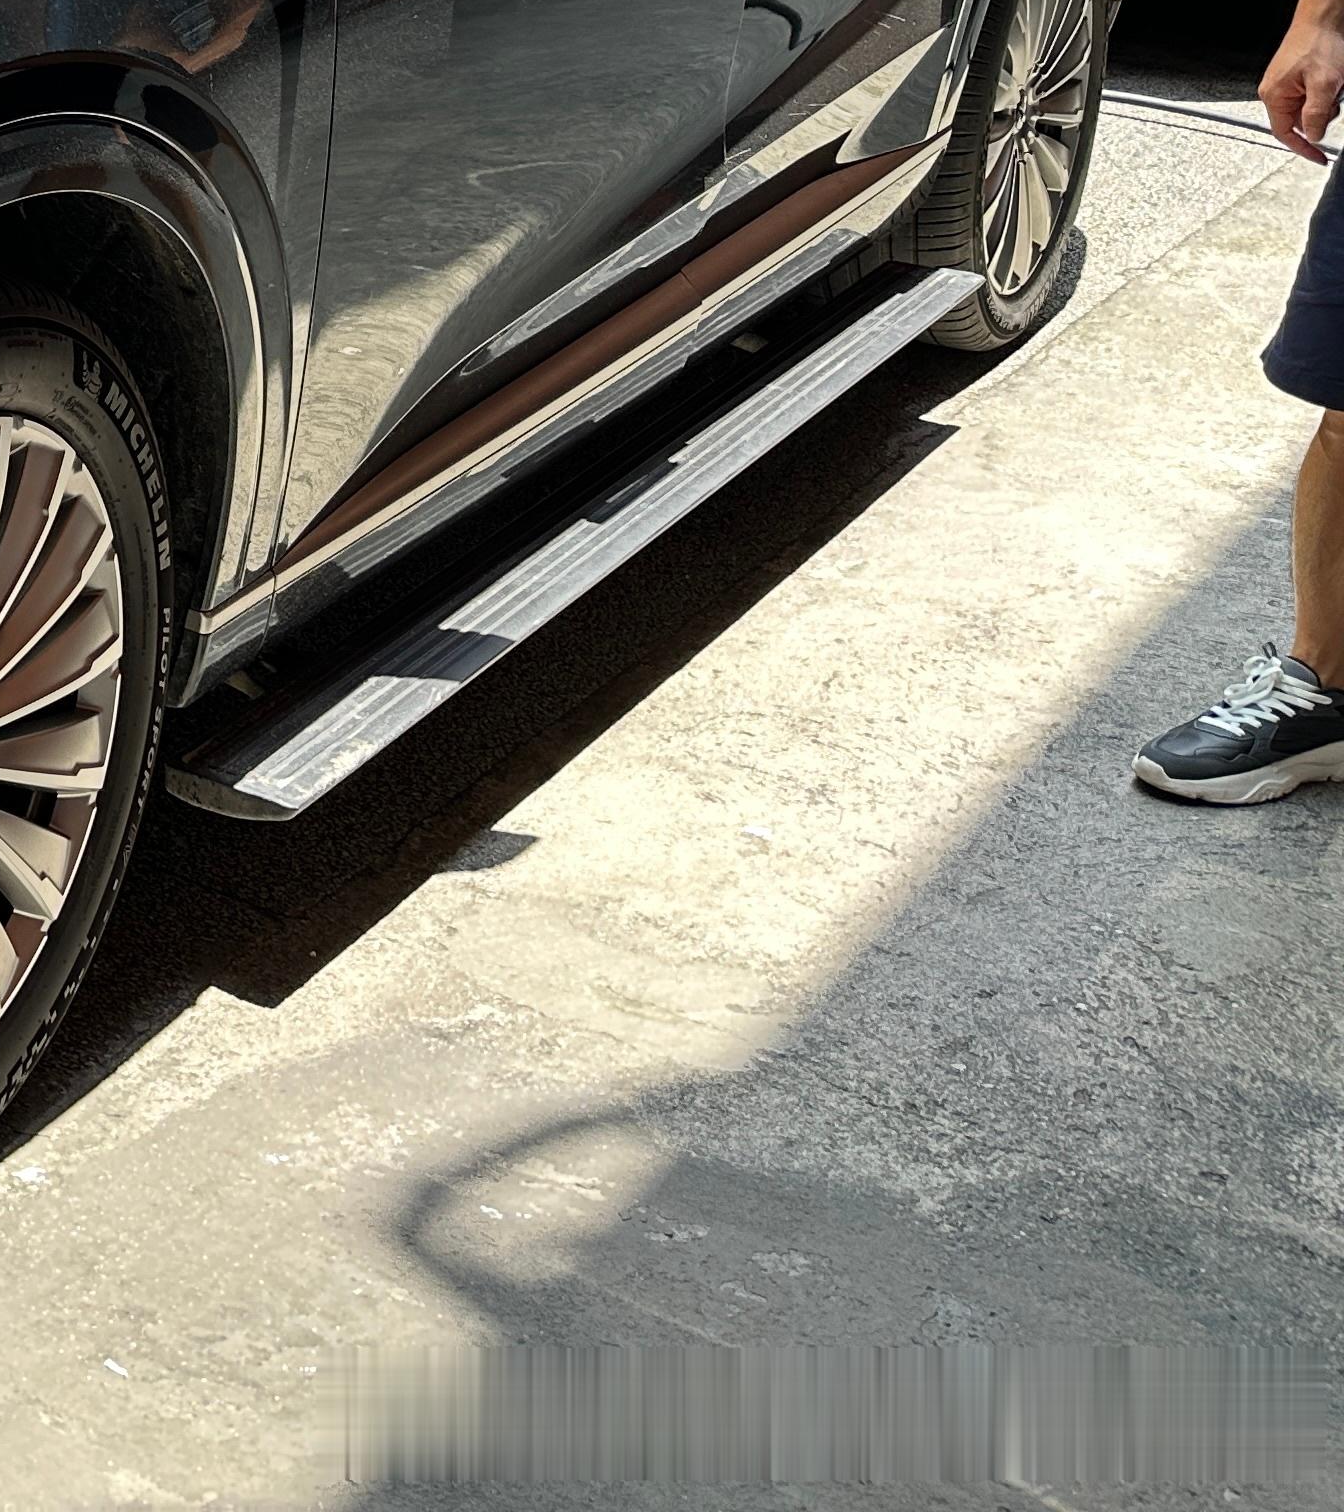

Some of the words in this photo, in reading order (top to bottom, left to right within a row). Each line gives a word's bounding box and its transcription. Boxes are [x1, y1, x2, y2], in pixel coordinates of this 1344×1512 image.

[104, 380, 172, 572] MICHELIN
[158, 607, 172, 689] PILOT
[137, 705, 163, 816] SPORT
